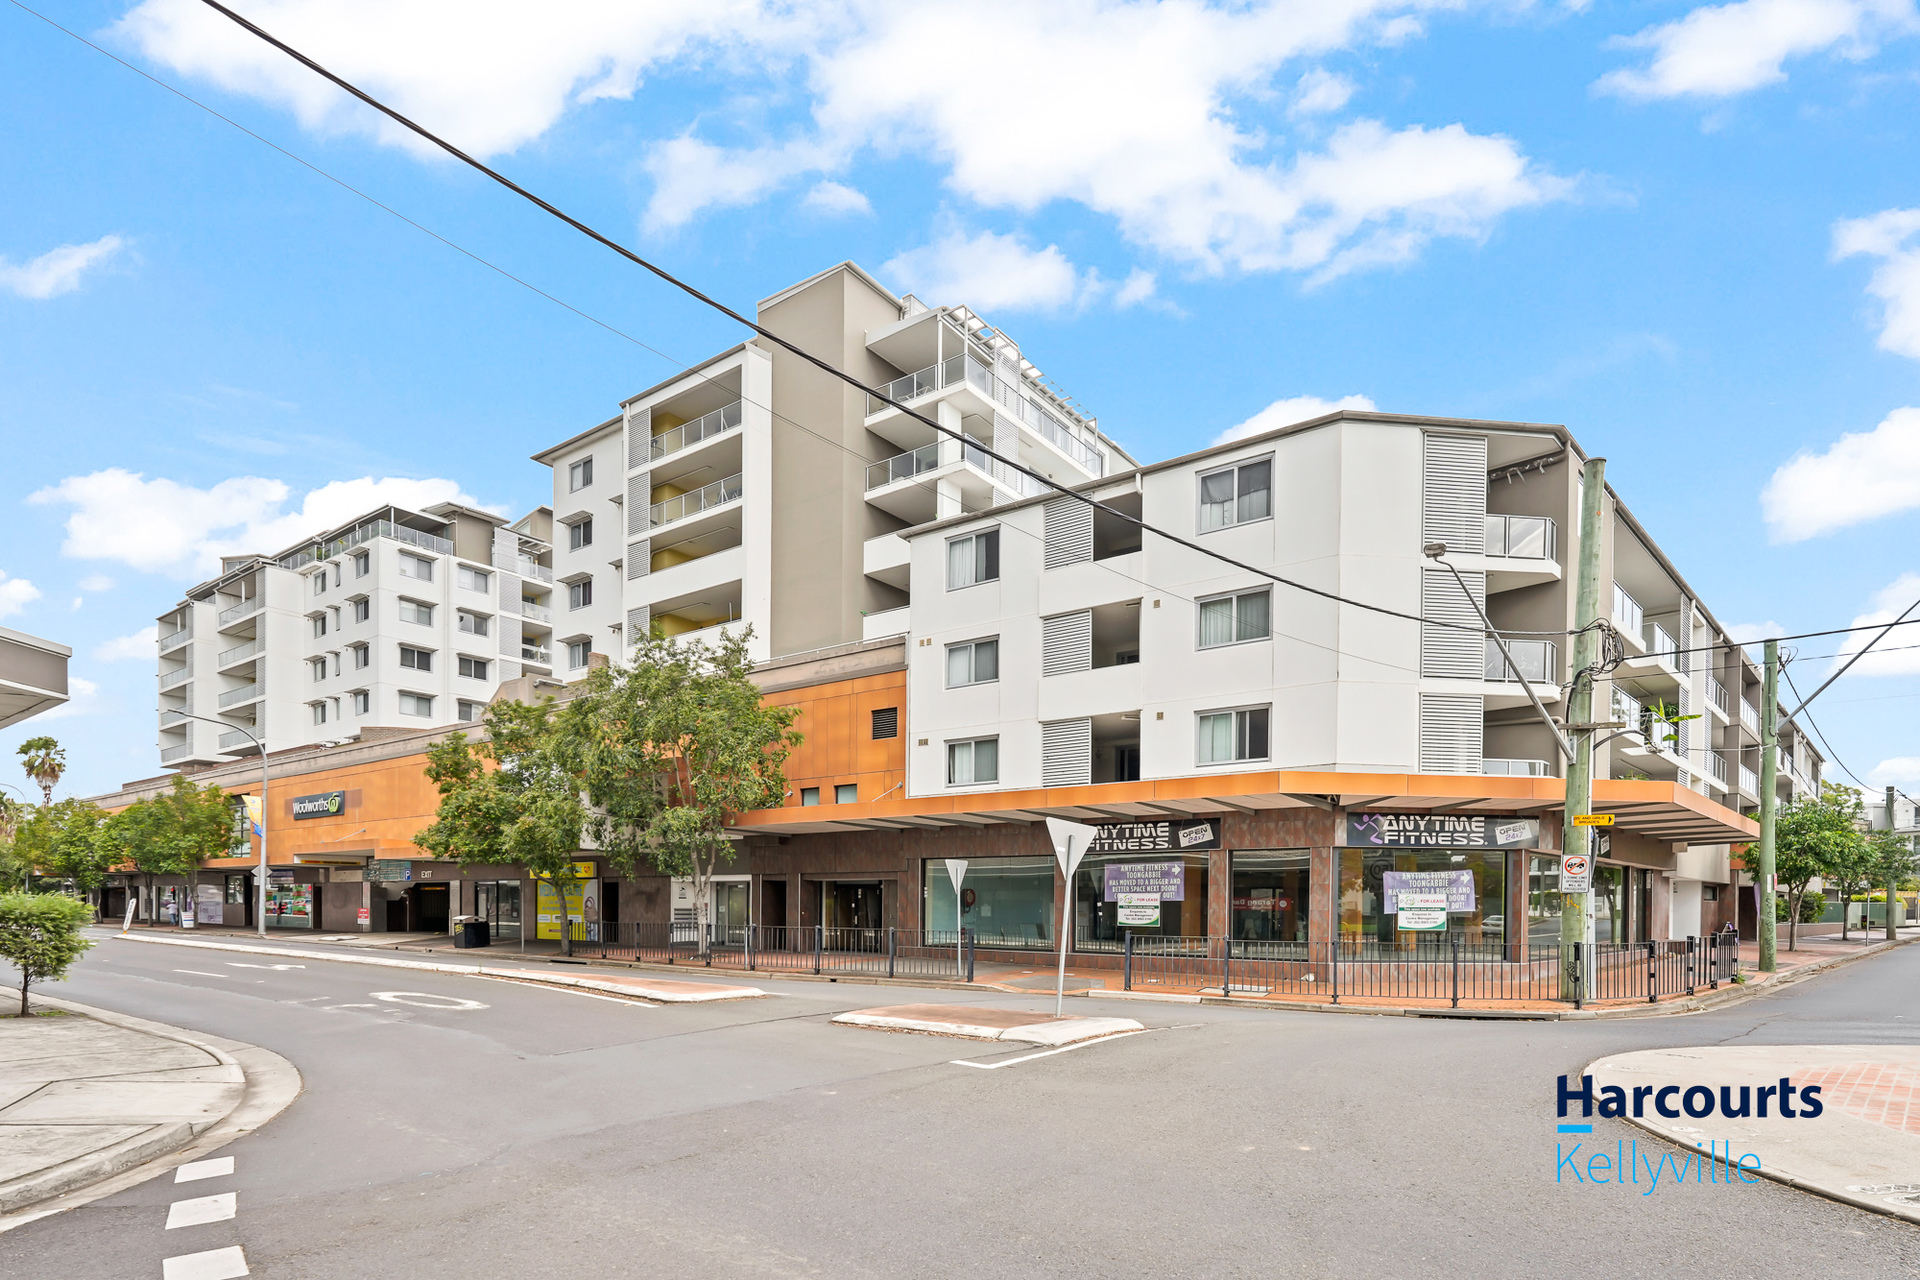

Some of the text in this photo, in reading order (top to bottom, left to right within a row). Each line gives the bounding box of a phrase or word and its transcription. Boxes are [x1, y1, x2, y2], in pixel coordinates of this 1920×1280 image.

[292, 798, 328, 814] Woolworths
[1383, 815, 1485, 832] ANYTIME
[1095, 822, 1169, 839] NYTIME
[1182, 826, 1208, 838] OPEN
[1499, 824, 1526, 835] OPEN
[1120, 863, 1168, 872] ANYTIME FITNESS
[421, 870, 432, 878] EXIT
[1432, 871, 1456, 879] FITNESS
